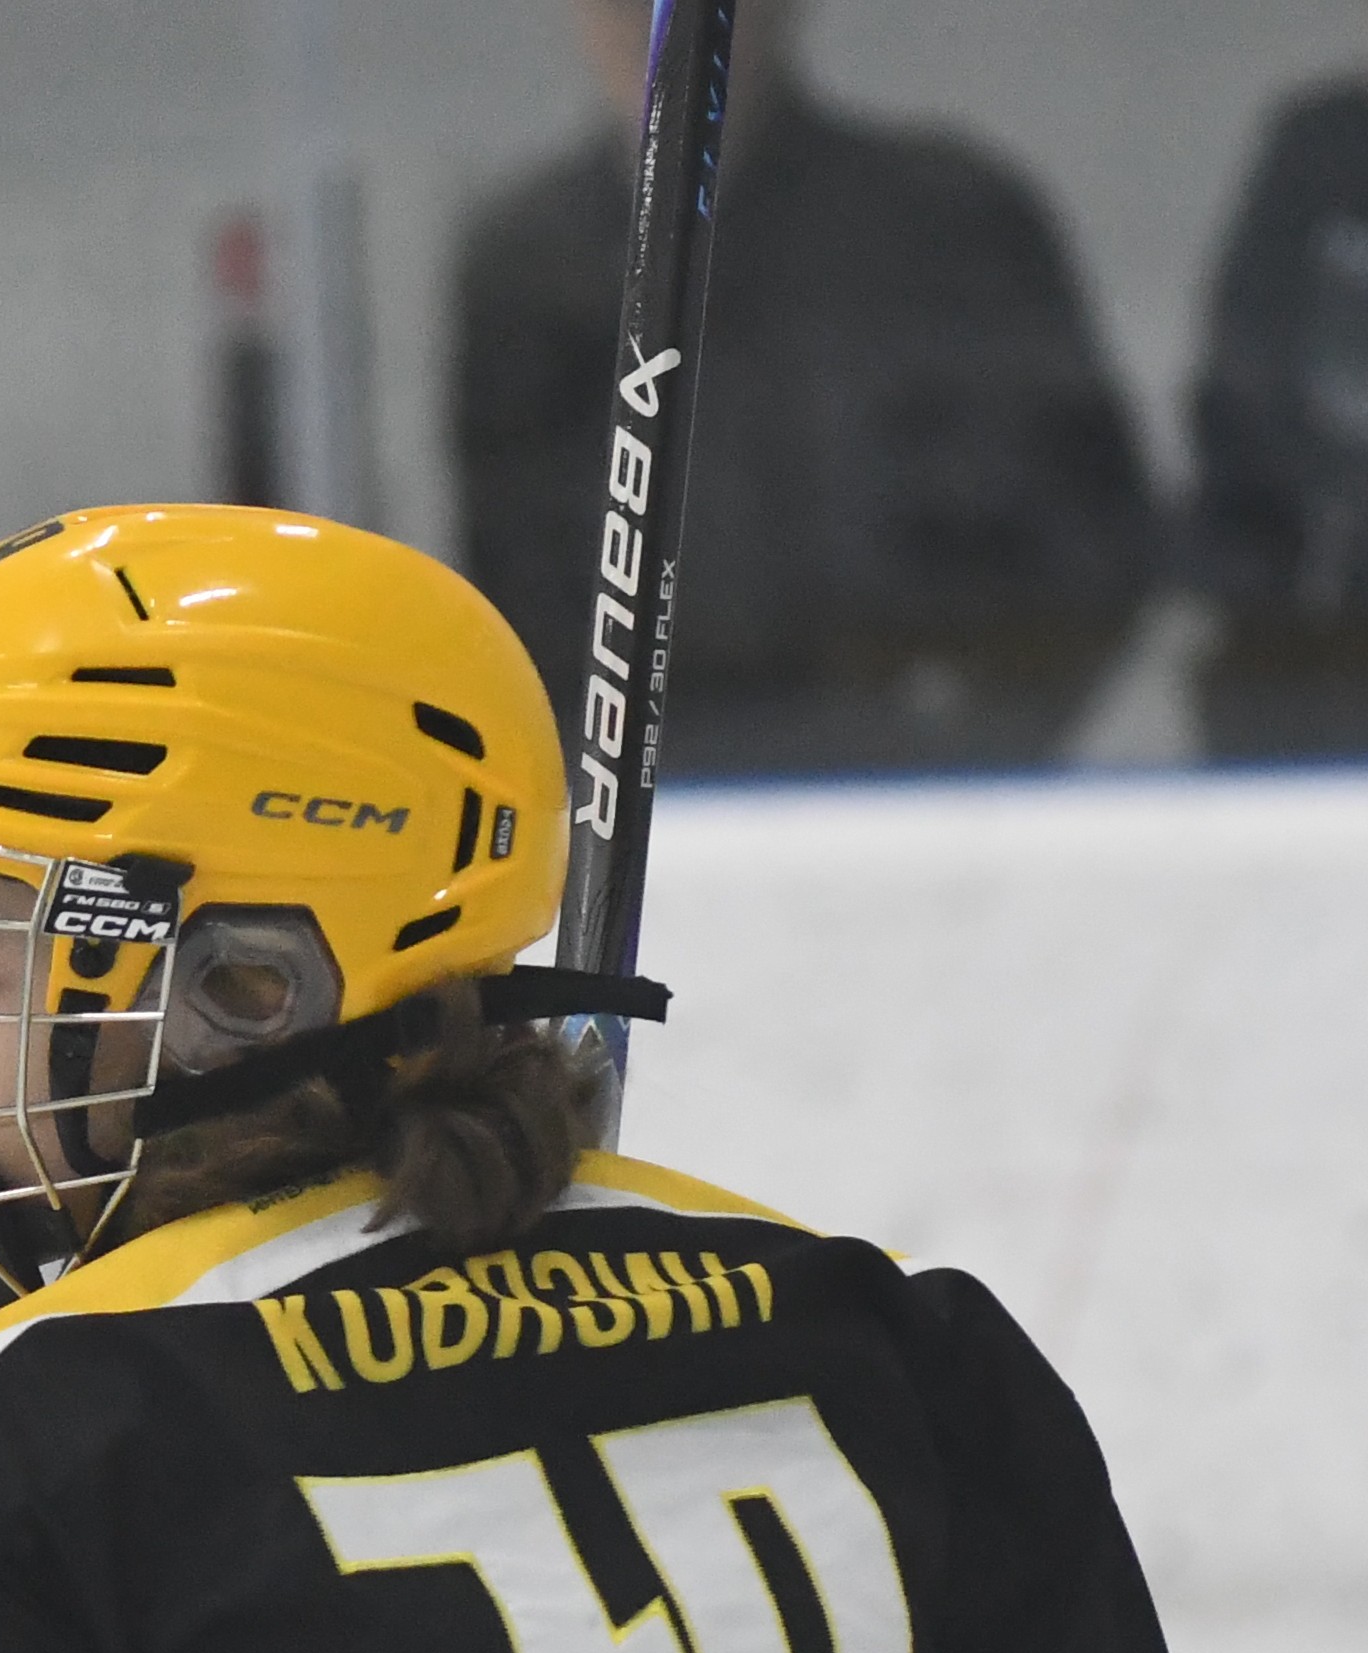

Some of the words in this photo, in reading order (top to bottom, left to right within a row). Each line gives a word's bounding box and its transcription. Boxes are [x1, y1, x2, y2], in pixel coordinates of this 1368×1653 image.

[655, 558, 676, 641] FLEX
[575, 425, 652, 841] BAUER
[650, 649, 667, 693] 30
[640, 723, 660, 789] P92
[251, 790, 411, 834] CCM
[53, 911, 172, 941] CCM
